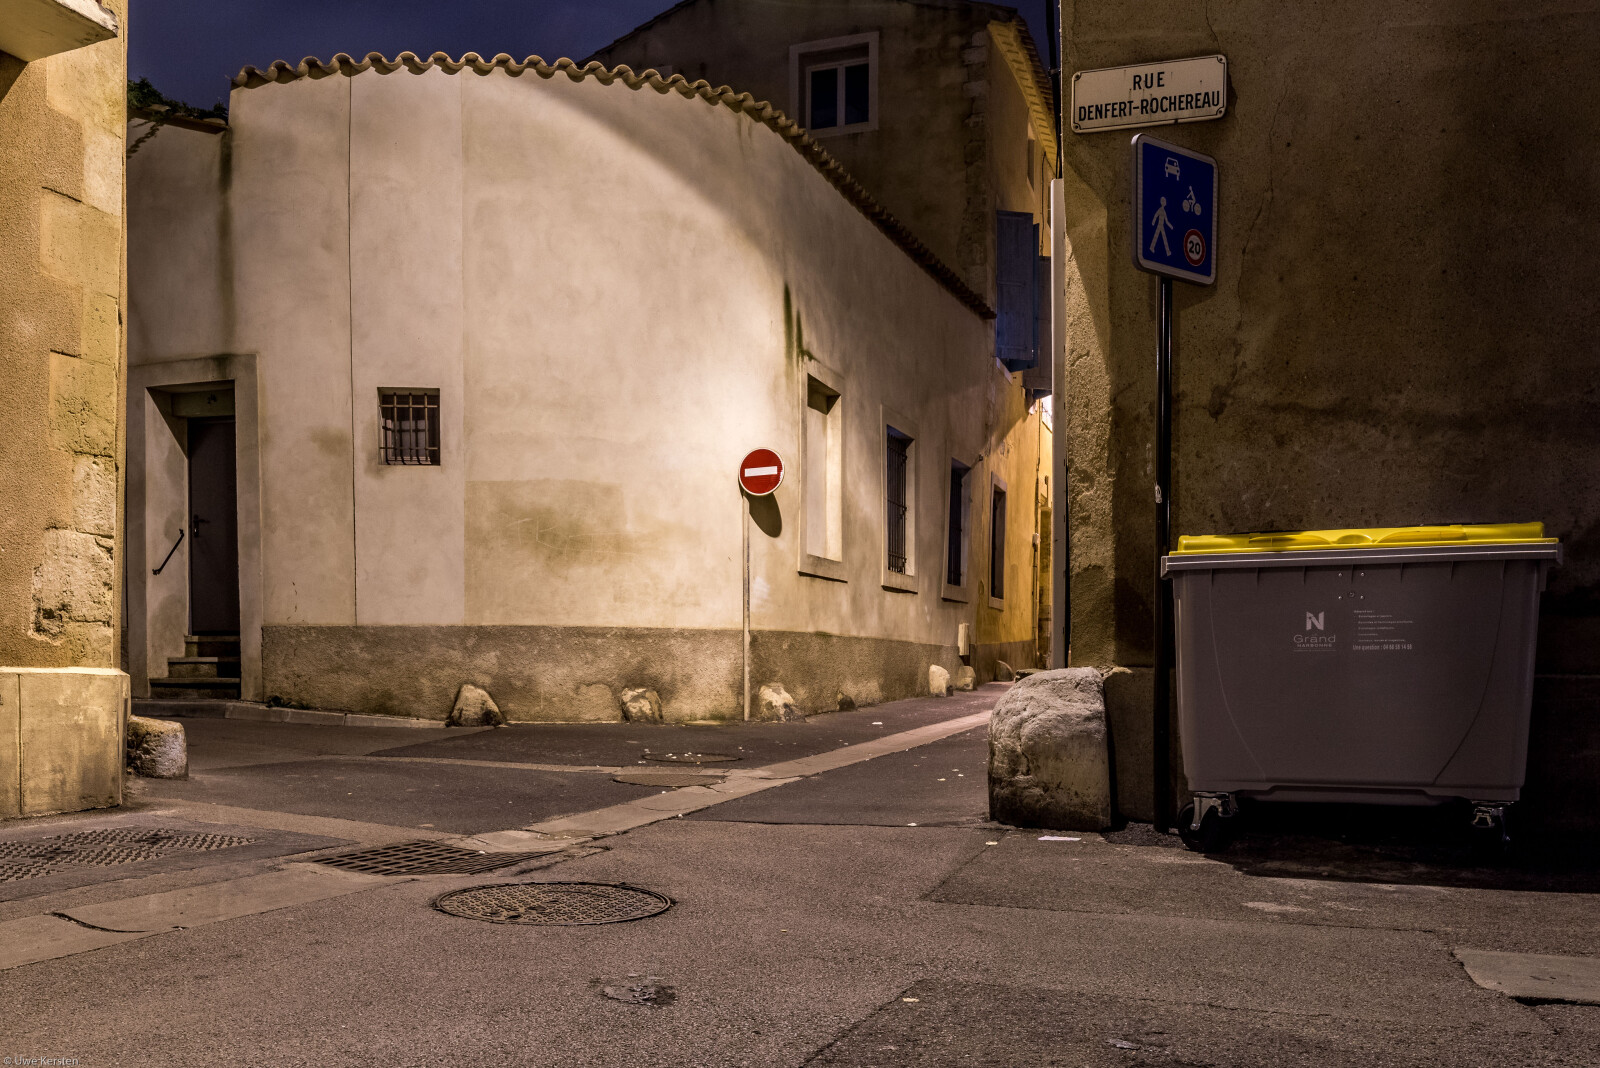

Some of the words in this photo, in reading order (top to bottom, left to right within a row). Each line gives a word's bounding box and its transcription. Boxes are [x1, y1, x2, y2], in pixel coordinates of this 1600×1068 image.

[1133, 71, 1165, 91] RUE
[1078, 90, 1220, 122] DENFERT-ROCHEREAU
[1188, 240, 1201, 255] 20
[1306, 611, 1325, 631] N
[1293, 634, 1336, 643] Grand
